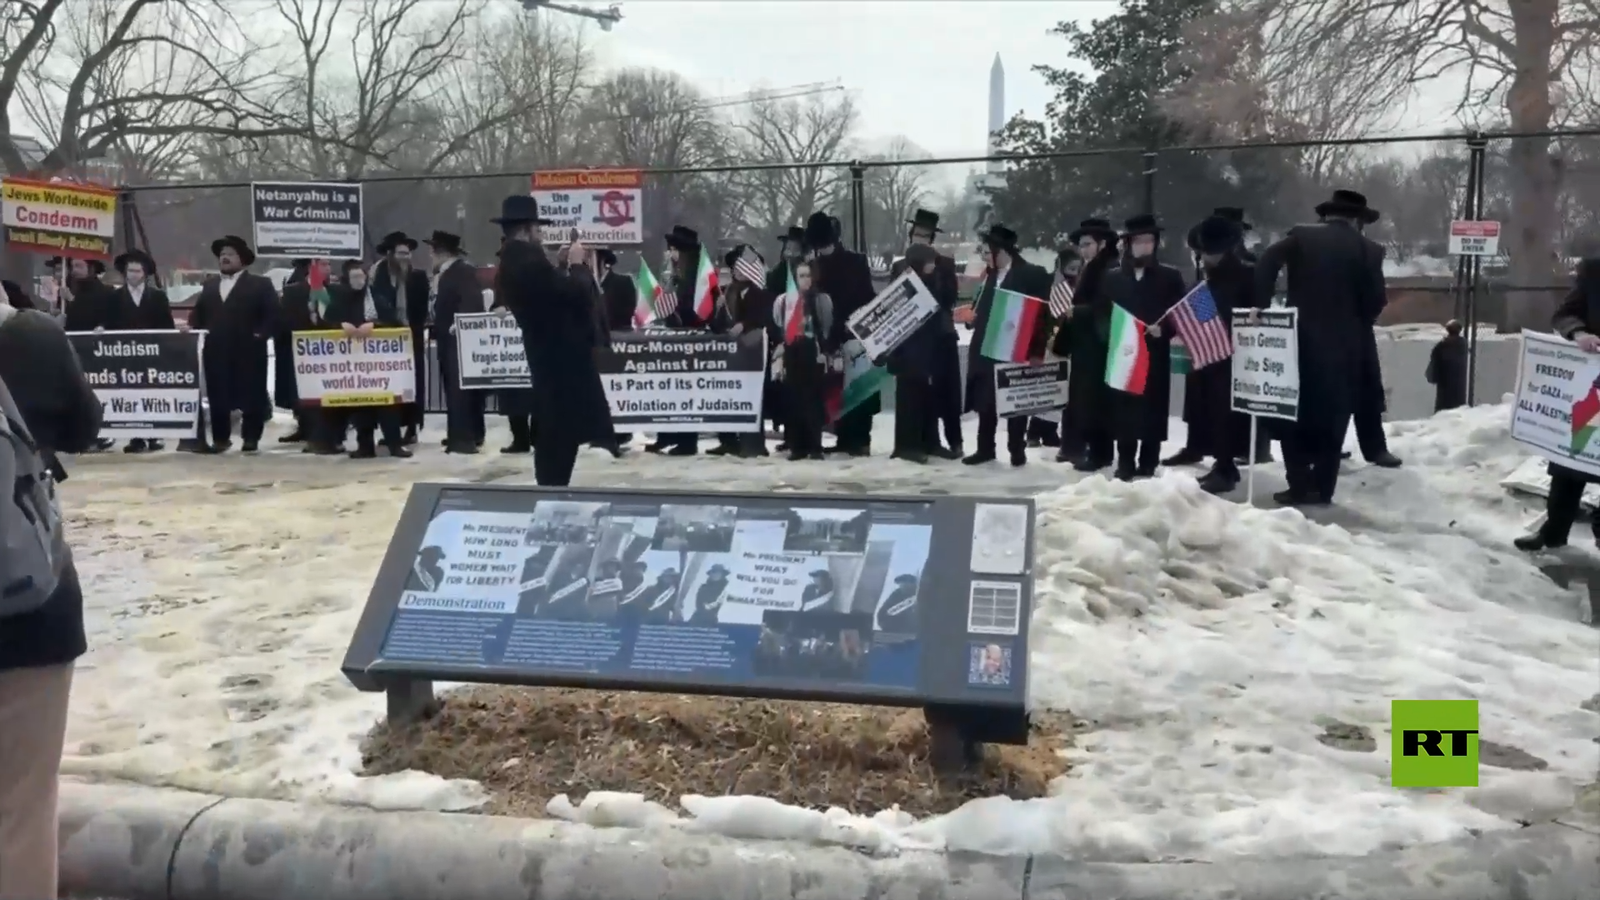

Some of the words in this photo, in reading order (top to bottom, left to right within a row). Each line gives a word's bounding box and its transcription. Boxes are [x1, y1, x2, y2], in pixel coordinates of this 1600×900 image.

[7, 188, 41, 202] Jews
[44, 191, 109, 211] Worldwide
[256, 189, 329, 203] Netanyahu
[332, 190, 345, 202] is
[348, 194, 358, 203] a
[551, 193, 570, 203] the
[262, 206, 290, 218] War
[293, 207, 351, 220] Criminal
[571, 203, 582, 214] of
[15, 205, 99, 231] Condemn
[580, 229, 637, 240] Atrocities
[460, 318, 487, 330] Israel
[489, 317, 498, 329] is
[296, 337, 335, 356] State
[338, 337, 353, 355] of
[356, 335, 410, 353] "Israel"
[489, 334, 501, 345] 77
[93, 340, 160, 357] Judaism
[611, 340, 738, 354] War-Mongering
[472, 351, 499, 365] tragic
[297, 361, 327, 374] does
[329, 360, 351, 373] not
[354, 358, 413, 374] represent
[624, 359, 688, 374] Against
[692, 358, 728, 370] Iran
[121, 368, 144, 384] for
[147, 368, 195, 384] Peace
[322, 375, 355, 390] world
[357, 375, 391, 390] Jewry
[610, 379, 623, 391] Is
[626, 379, 655, 391] Part
[658, 378, 672, 390] of
[675, 378, 693, 390] its
[696, 377, 743, 390] Crimes
[1540, 384, 1561, 399] GAZA
[111, 397, 139, 413] War
[141, 397, 171, 413] With
[617, 399, 676, 412] Violation
[681, 398, 693, 411] of
[697, 398, 753, 411] Judaism
[1519, 399, 1533, 413] ALL
[1535, 402, 1573, 424] PALESTINE
[491, 538, 519, 547] LONG
[467, 550, 502, 559] MUST
[450, 563, 488, 572] WOMEN
[490, 563, 517, 573] WAIT
[754, 564, 788, 574] WHAT
[466, 576, 516, 587] LIBERTY
[736, 573, 758, 583] WILL
[761, 576, 779, 585] YOU
[404, 593, 506, 610] Demonstration
